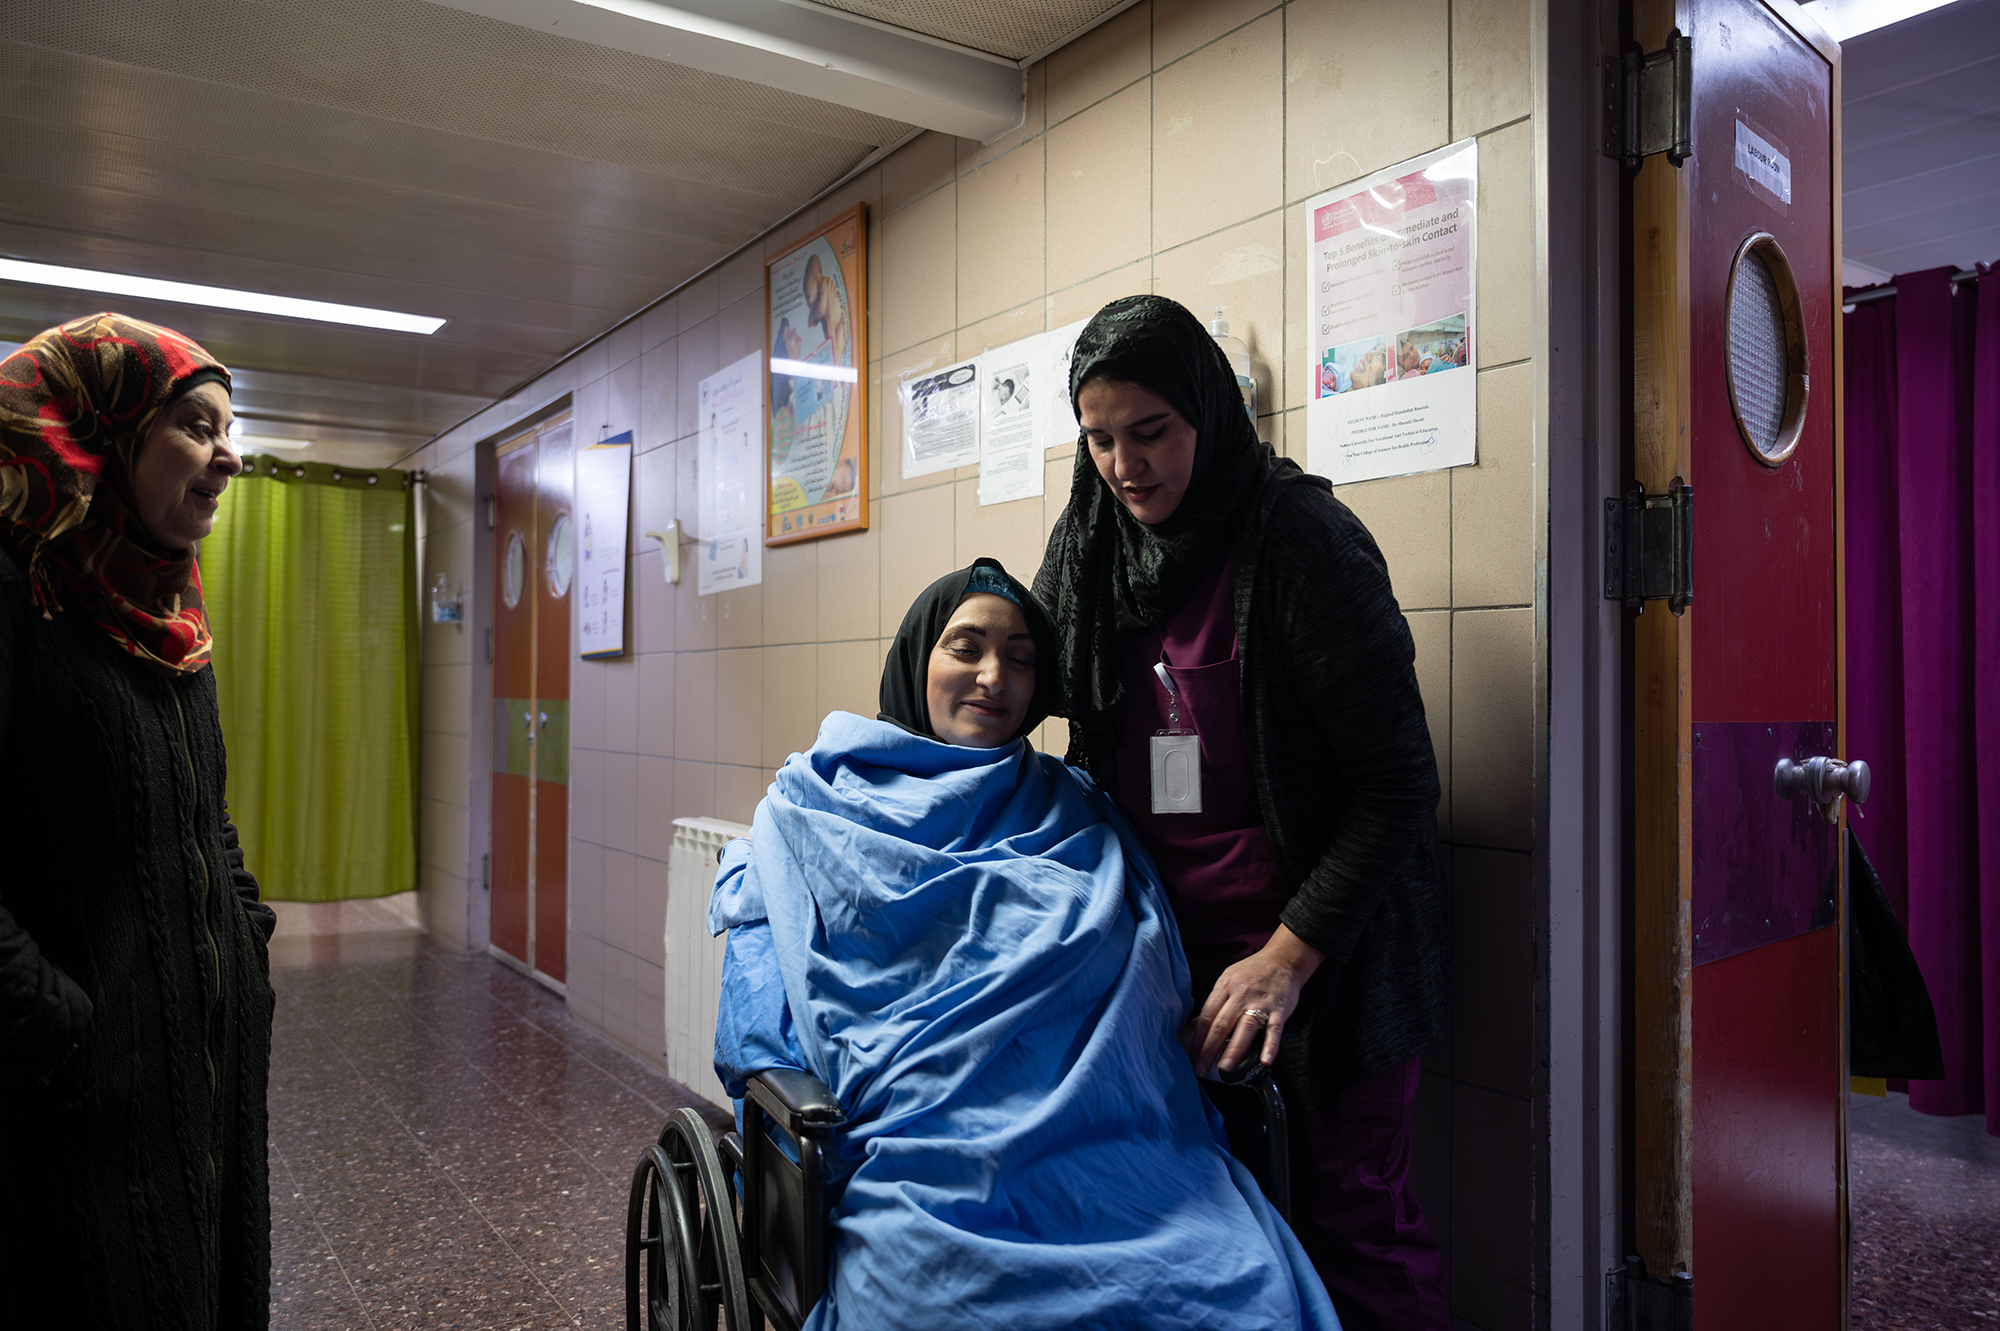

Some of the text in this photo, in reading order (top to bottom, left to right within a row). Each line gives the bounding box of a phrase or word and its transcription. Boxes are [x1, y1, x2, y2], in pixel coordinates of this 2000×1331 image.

[1748, 144, 1766, 165] LABOUR
[1323, 251, 1337, 261] Top
[1339, 247, 1344, 256] 5
[1345, 236, 1379, 254] Benefits
[1441, 207, 1459, 223] and
[1326, 223, 1458, 272] Prolonged Skin-to-skin Contact
[1442, 266, 1463, 276] depression
[1347, 417, 1365, 425] STUDENT
[1351, 426, 1377, 435] INSTRUCTOR
[1375, 434, 1393, 442] Vocational
